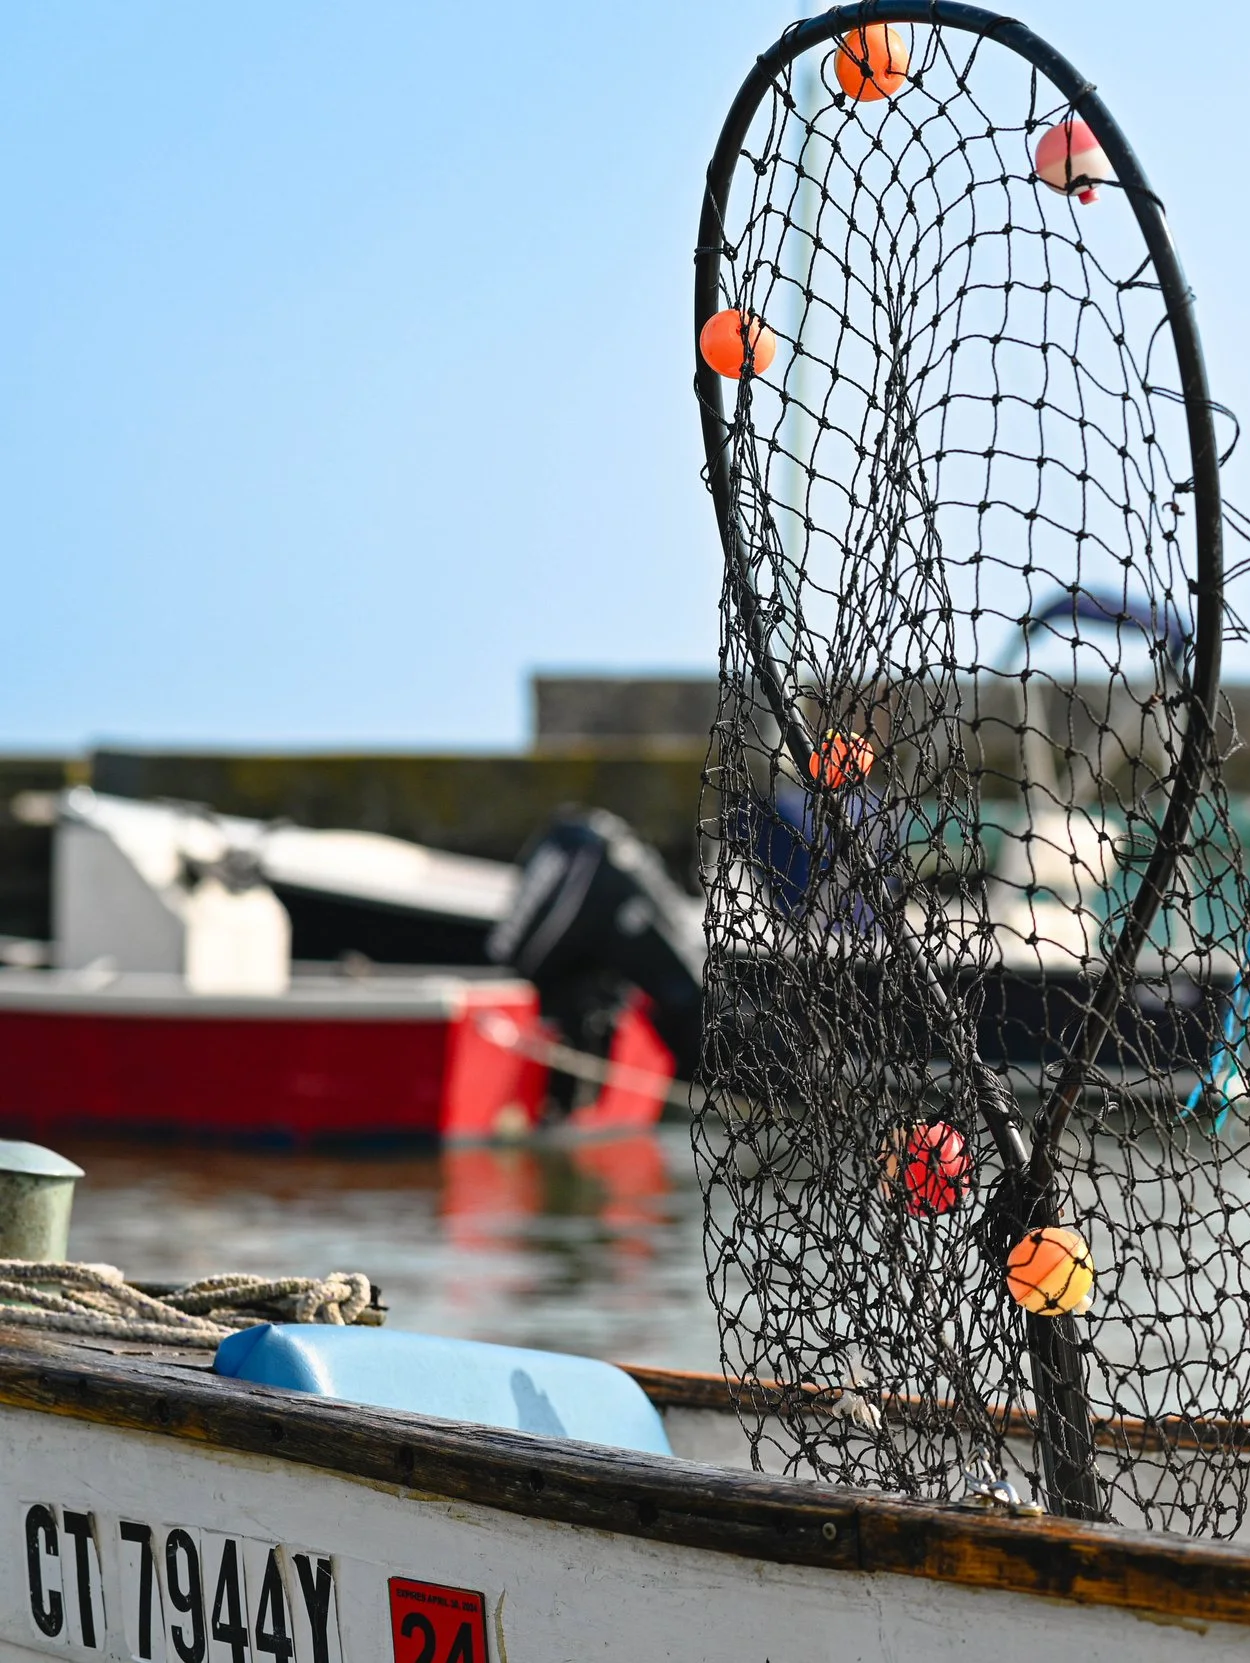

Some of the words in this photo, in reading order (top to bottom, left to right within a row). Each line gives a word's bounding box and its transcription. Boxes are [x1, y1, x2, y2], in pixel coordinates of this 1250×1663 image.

[25, 1503, 97, 1649] CT
[119, 1521, 332, 1663] 7944Y
[396, 1588, 426, 1603] EXPIRES
[427, 1594, 448, 1607] APRIL
[401, 1611, 474, 1663] 24
